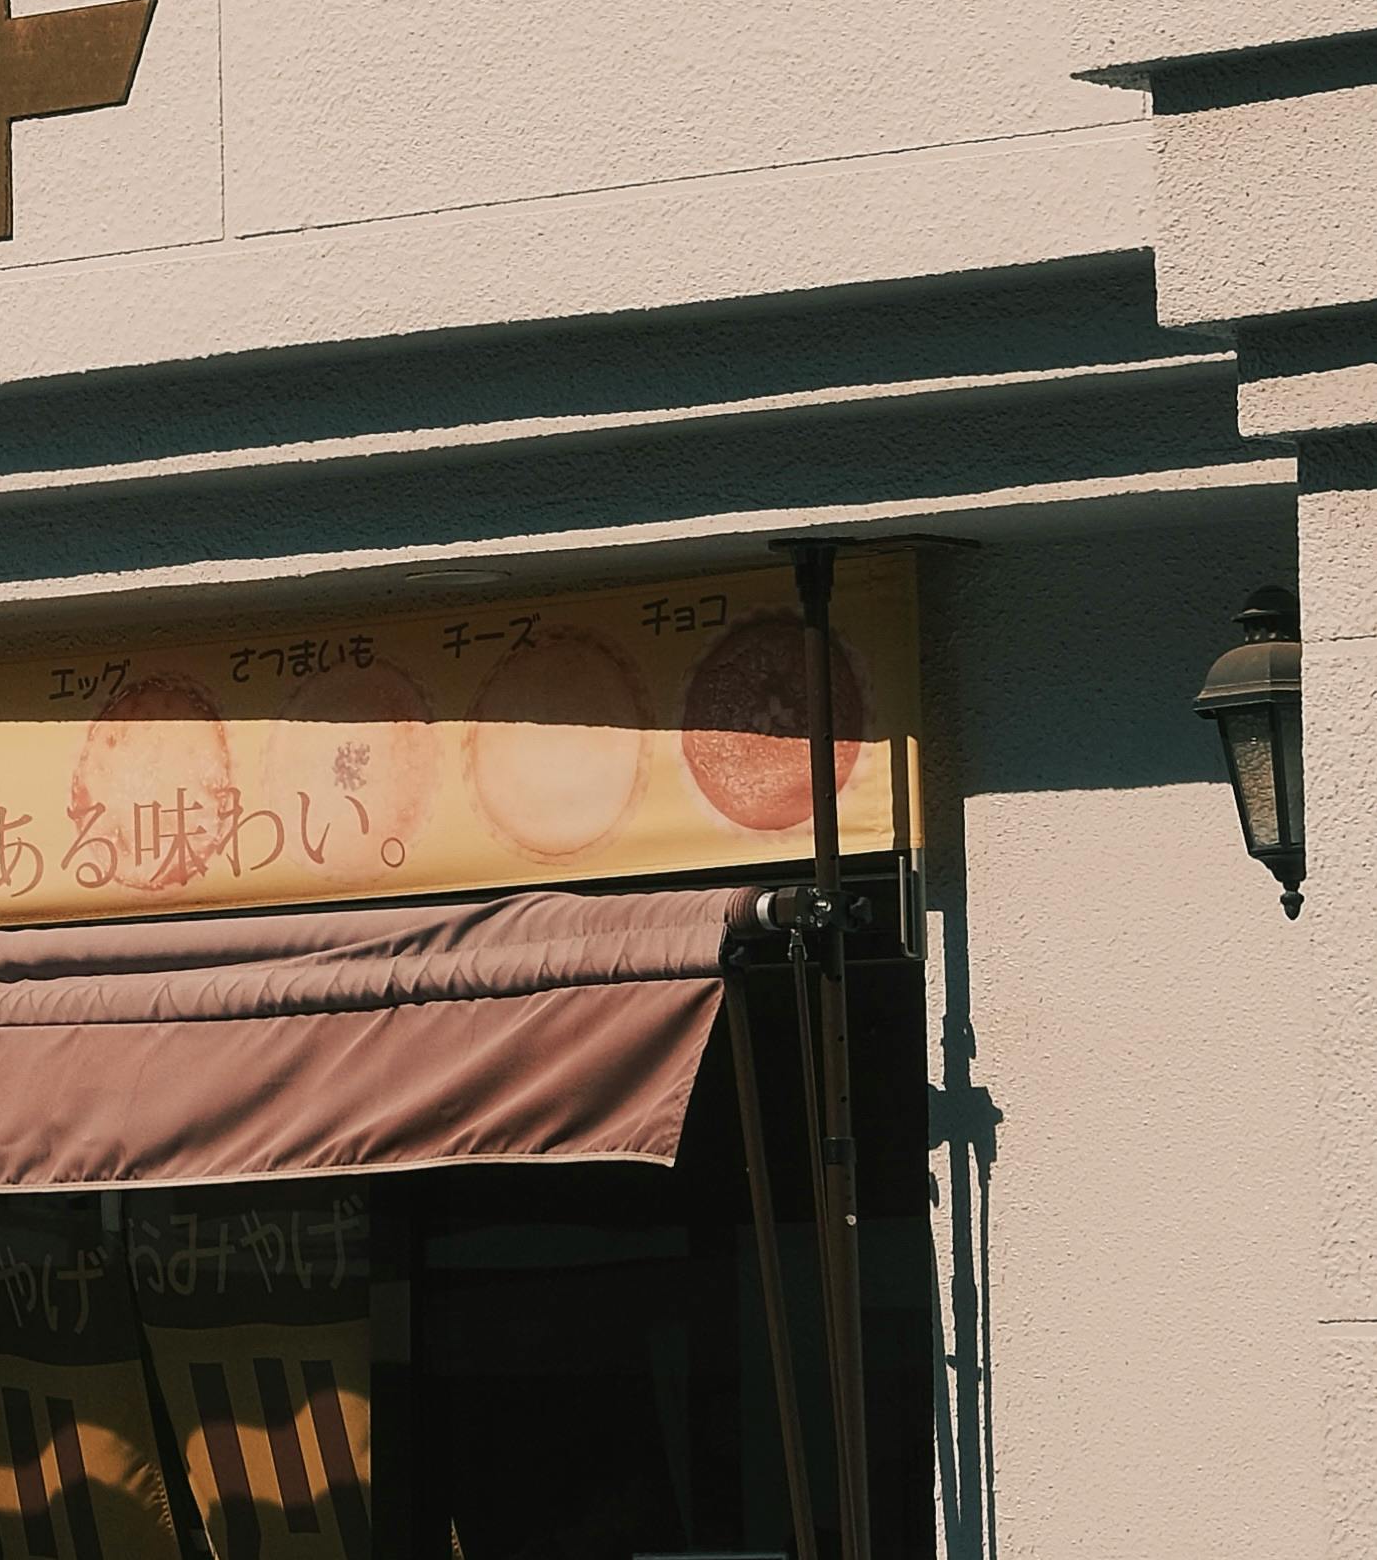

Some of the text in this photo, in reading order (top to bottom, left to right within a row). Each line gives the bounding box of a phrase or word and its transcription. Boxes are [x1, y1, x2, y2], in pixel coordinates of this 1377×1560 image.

[442, 613, 543, 659] チーズ
[640, 593, 729, 636] チョコ
[229, 634, 377, 684] さつまいも
[49, 660, 134, 703] エッグ
